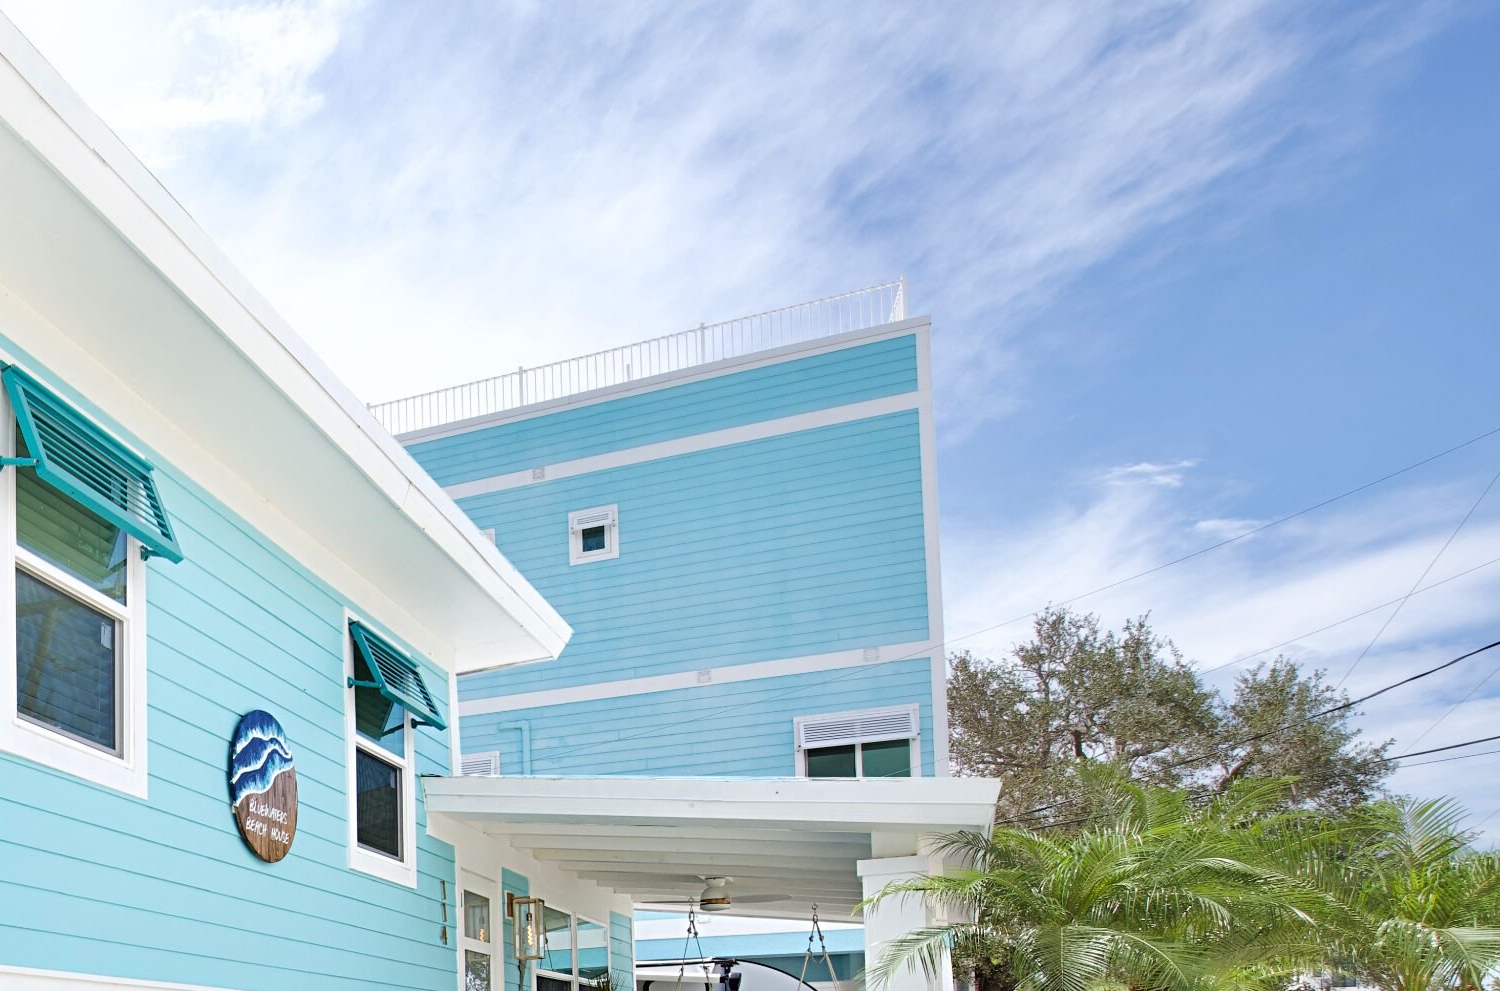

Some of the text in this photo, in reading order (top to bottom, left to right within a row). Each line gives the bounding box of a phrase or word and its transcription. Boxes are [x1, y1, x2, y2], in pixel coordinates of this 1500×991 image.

[250, 799, 287, 824] BLUEWATERS
[246, 816, 289, 844] BEACH HOUSE
